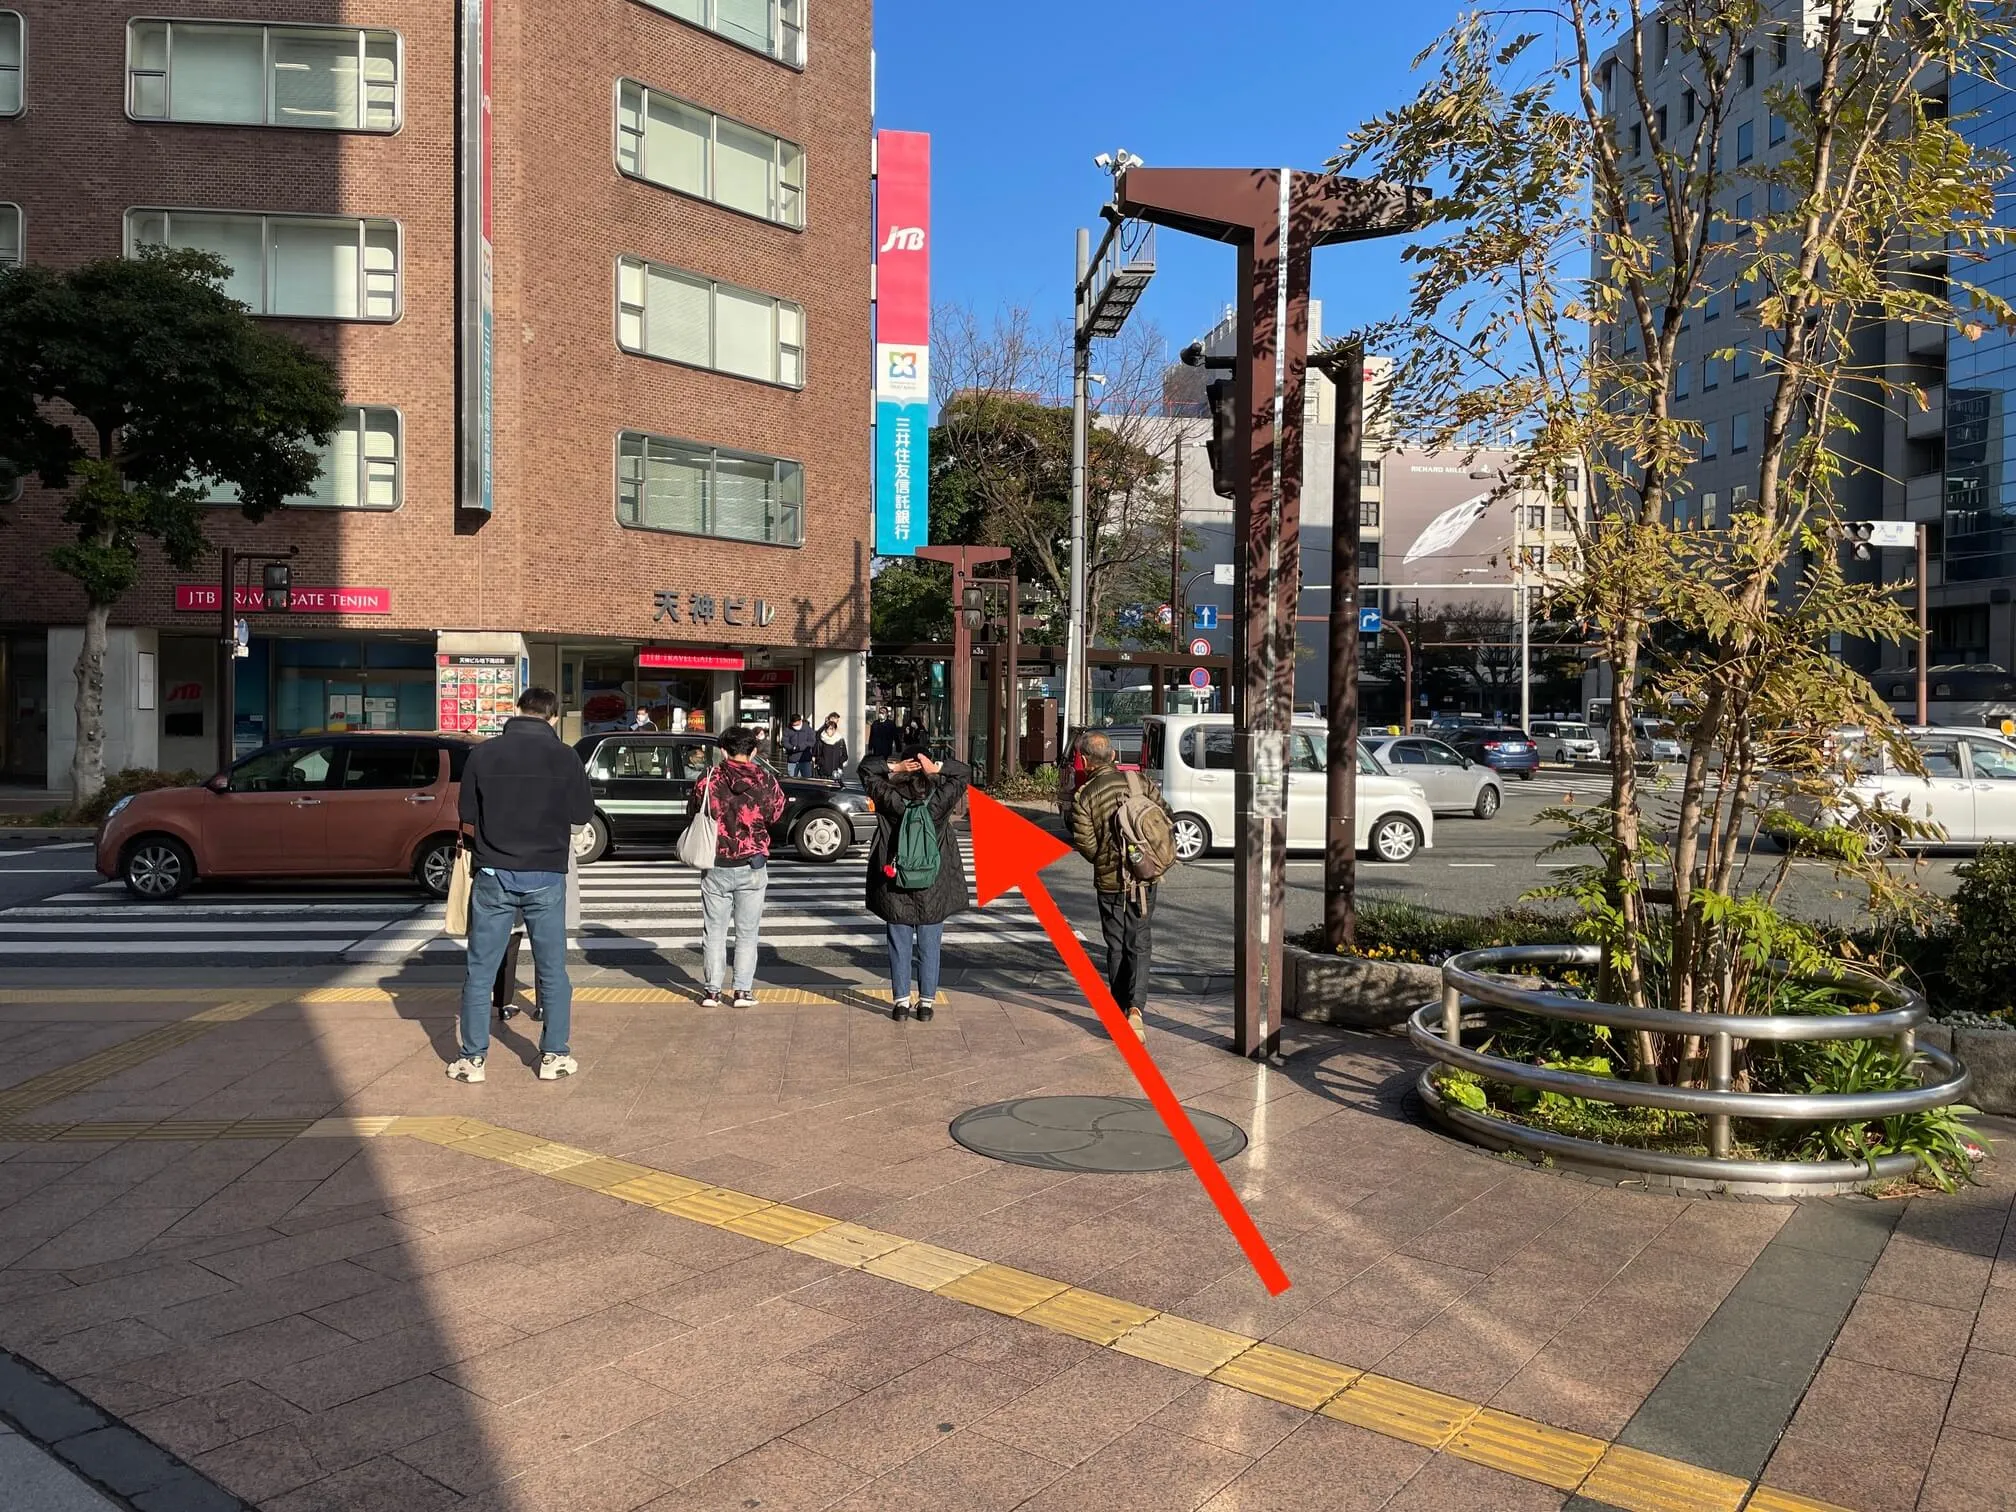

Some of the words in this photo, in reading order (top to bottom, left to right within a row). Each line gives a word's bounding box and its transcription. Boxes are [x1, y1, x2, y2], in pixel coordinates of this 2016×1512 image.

[880, 226, 926, 252] JTB
[894, 417, 911, 541] 三井住友信託銀行
[188, 591, 216, 605] JTB
[330, 594, 379, 608] TENJIN
[653, 590, 776, 627] 天神ビル
[1195, 644, 1206, 654] 40
